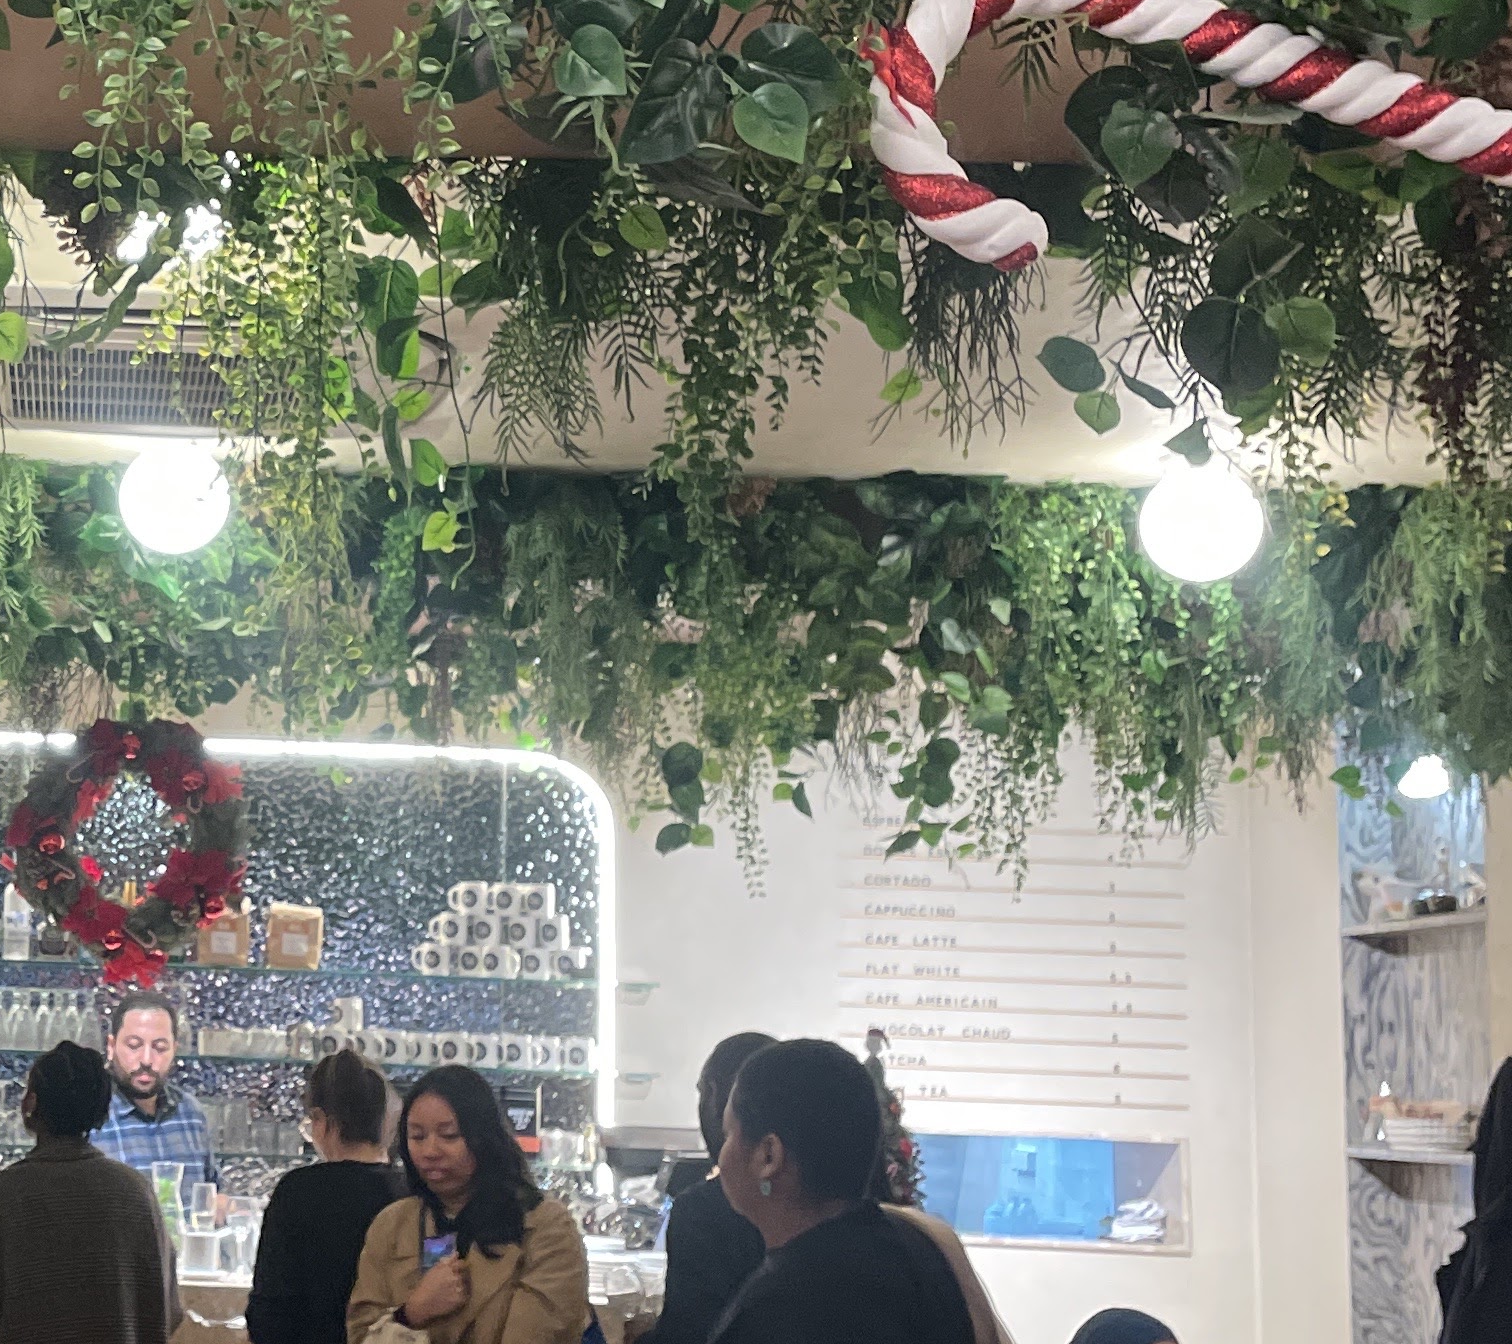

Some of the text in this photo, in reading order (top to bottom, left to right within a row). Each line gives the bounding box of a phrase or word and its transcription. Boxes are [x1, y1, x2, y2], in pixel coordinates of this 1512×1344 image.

[863, 875, 932, 888] CORTADO
[863, 904, 956, 918] CAPPUCCINO
[864, 934, 958, 948] CAFE LATTE
[864, 964, 899, 976] FLAT
[913, 965, 961, 977] WHITE
[864, 993, 998, 1009] CAFE AMERICAIN
[961, 1027, 1012, 1040] CHAUD
[881, 1055, 928, 1067] TCHA
[918, 1085, 949, 1098] TEA
